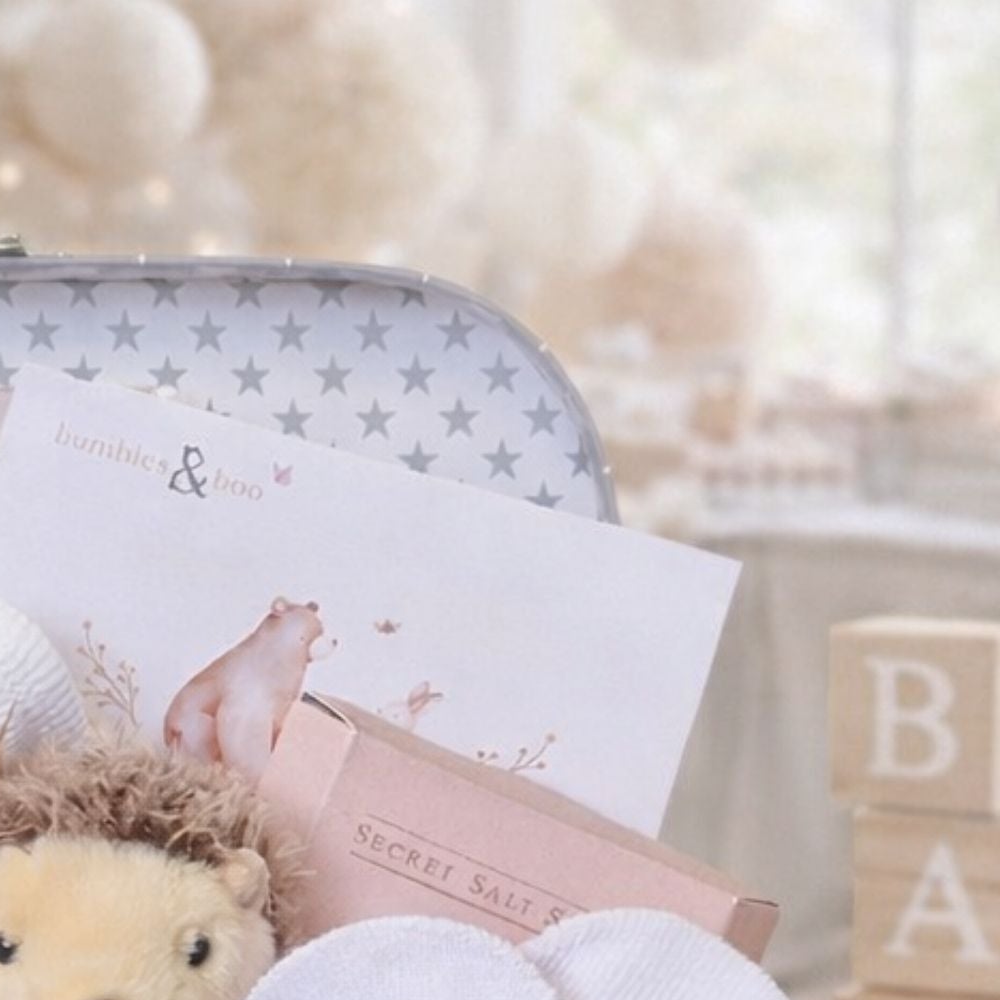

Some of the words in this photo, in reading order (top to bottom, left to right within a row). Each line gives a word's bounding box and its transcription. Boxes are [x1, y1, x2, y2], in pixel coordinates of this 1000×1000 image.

[169, 445, 207, 499] &
[212, 468, 264, 501] boo
[352, 823, 454, 883] SECRET
[467, 872, 533, 916] SALT
